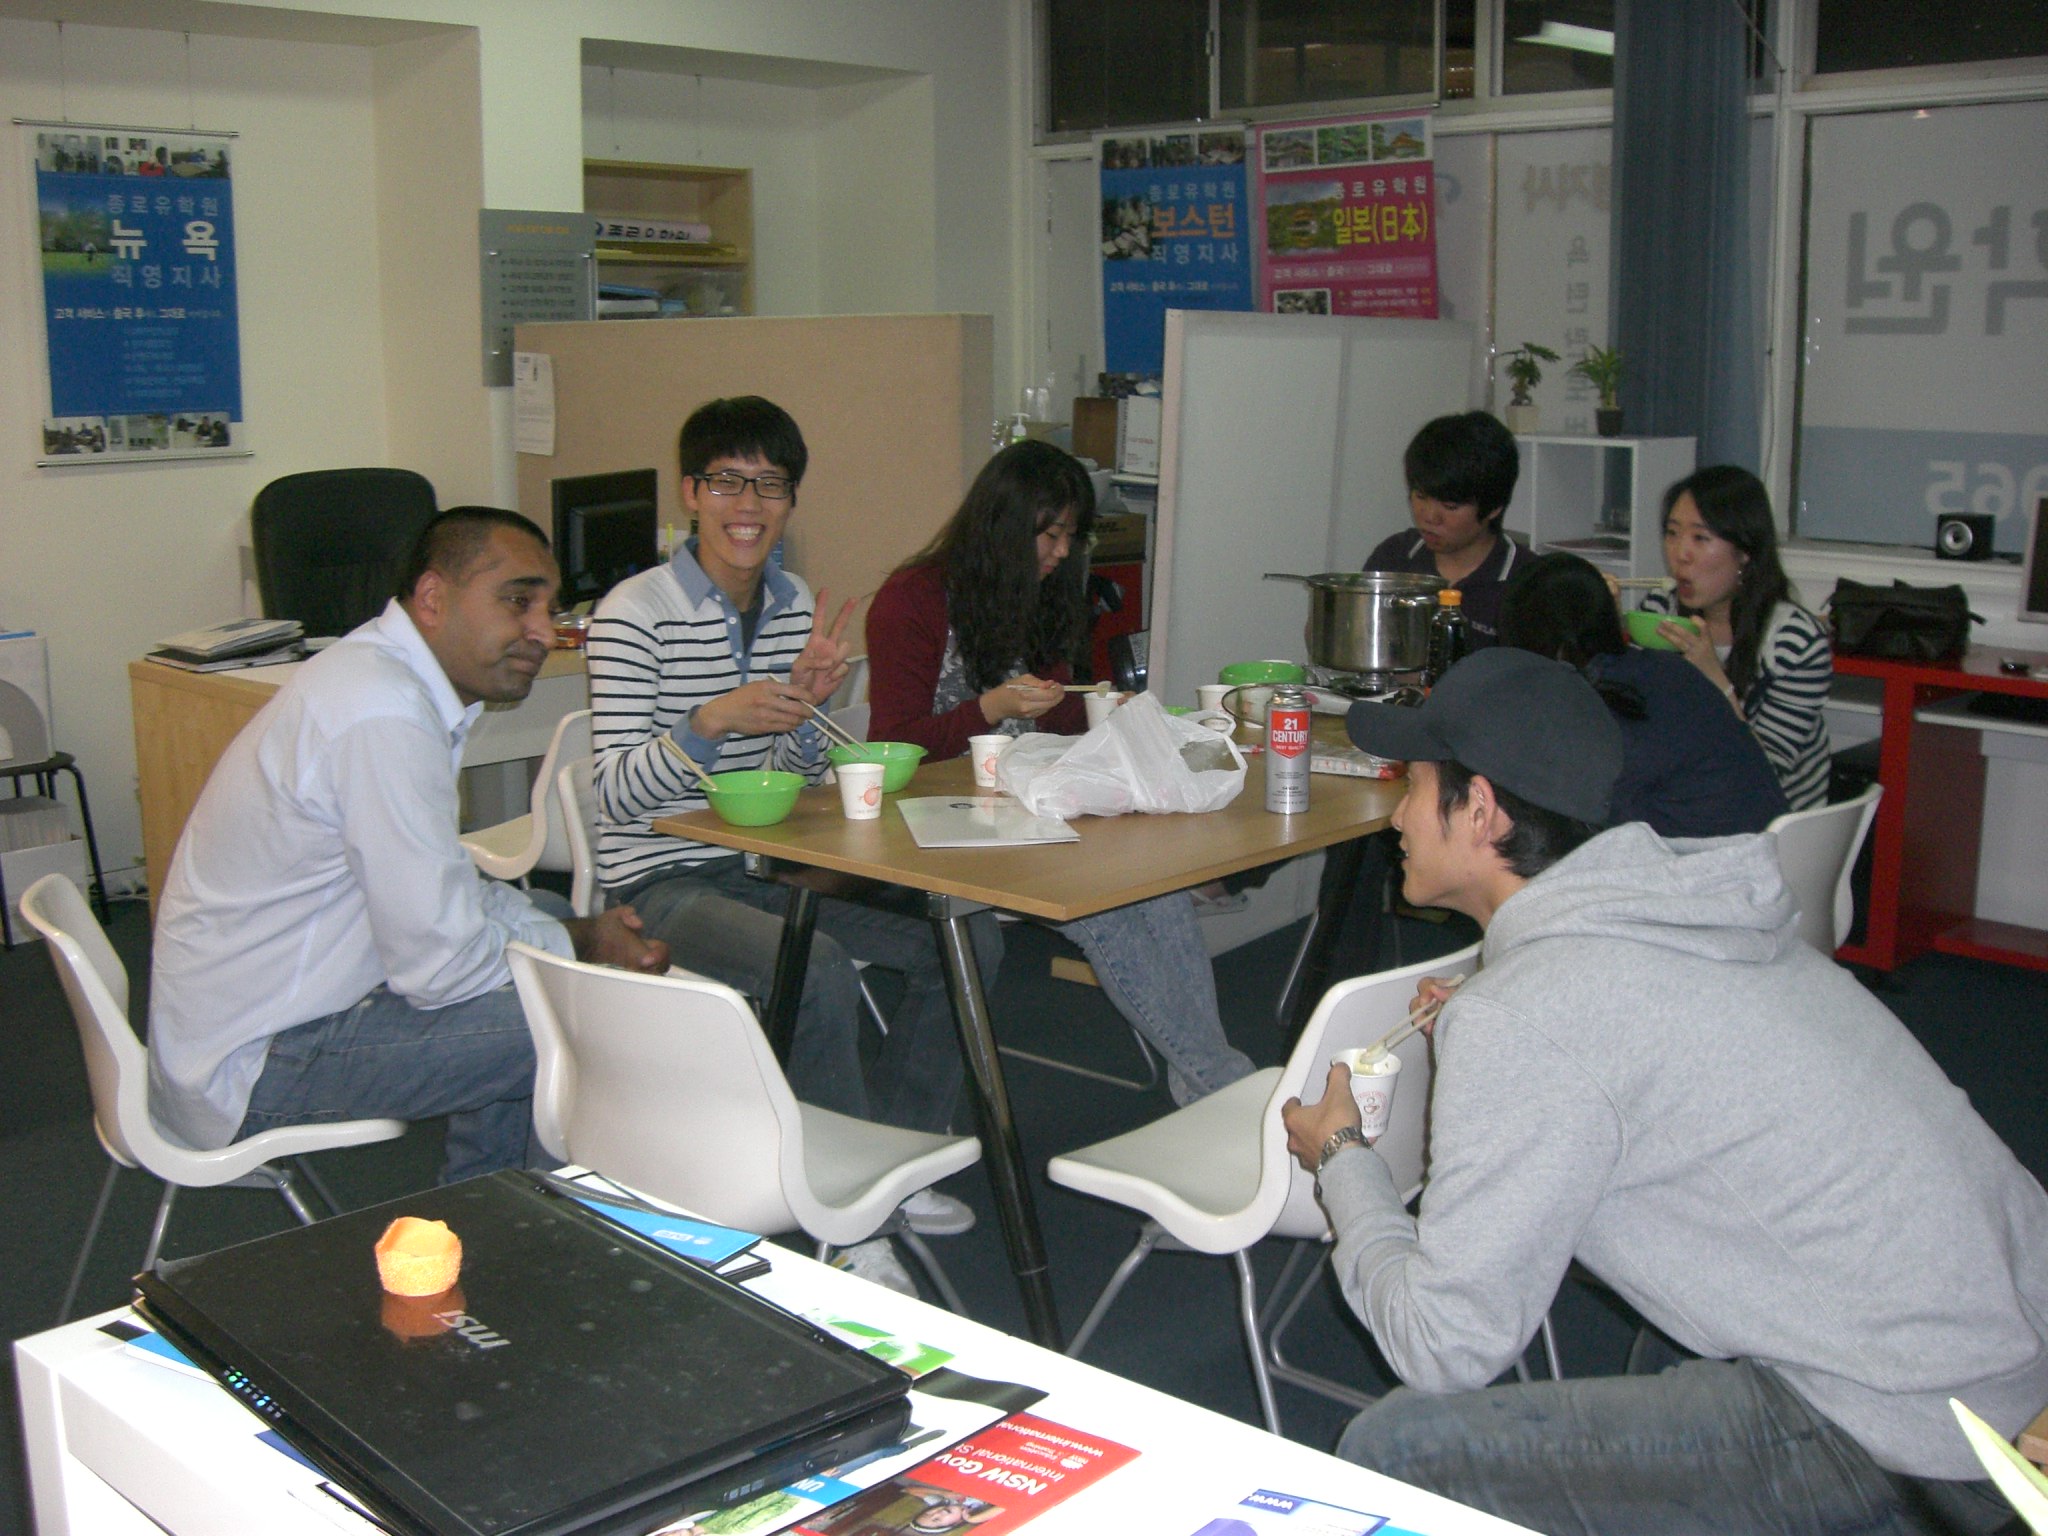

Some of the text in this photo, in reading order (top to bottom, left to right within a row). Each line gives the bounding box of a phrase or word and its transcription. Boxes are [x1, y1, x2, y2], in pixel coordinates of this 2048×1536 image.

[1151, 202, 1236, 239] 보스턴
[1332, 202, 1429, 246] 일본(日本)
[112, 264, 222, 289] 직영지사
[1272, 729, 1308, 743] CENTURY
[1284, 717, 1298, 731] 21
[432, 1310, 512, 1349] msi
[935, 1453, 1048, 1496] NSW Gov
[974, 1447, 1065, 1482] International
